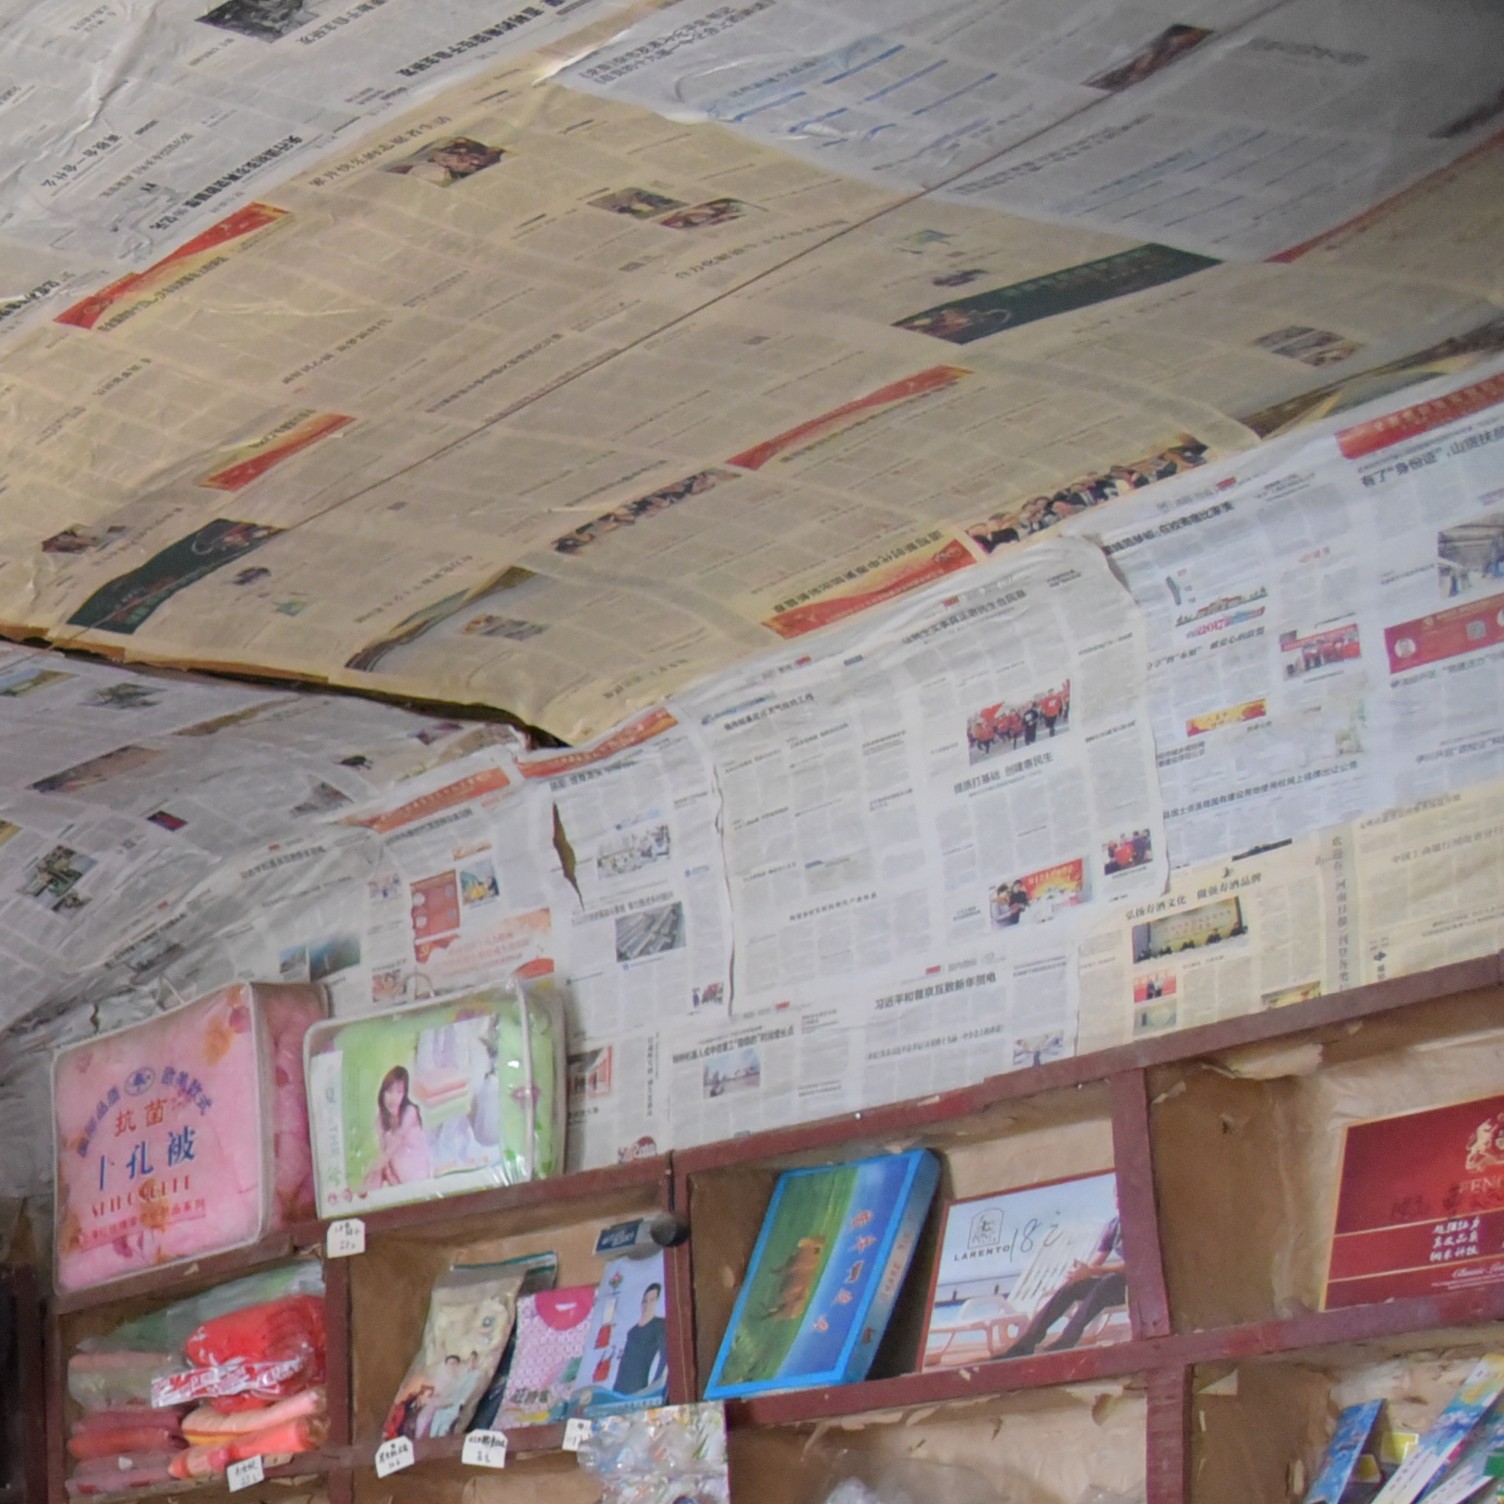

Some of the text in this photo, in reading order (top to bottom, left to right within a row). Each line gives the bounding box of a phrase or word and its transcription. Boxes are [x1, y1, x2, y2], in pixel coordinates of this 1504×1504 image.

[874, 971, 998, 1011] 习近平和普京互致新年贺电
[114, 1099, 167, 1137] 抗菌
[953, 1244, 1010, 1263] LARENTO
